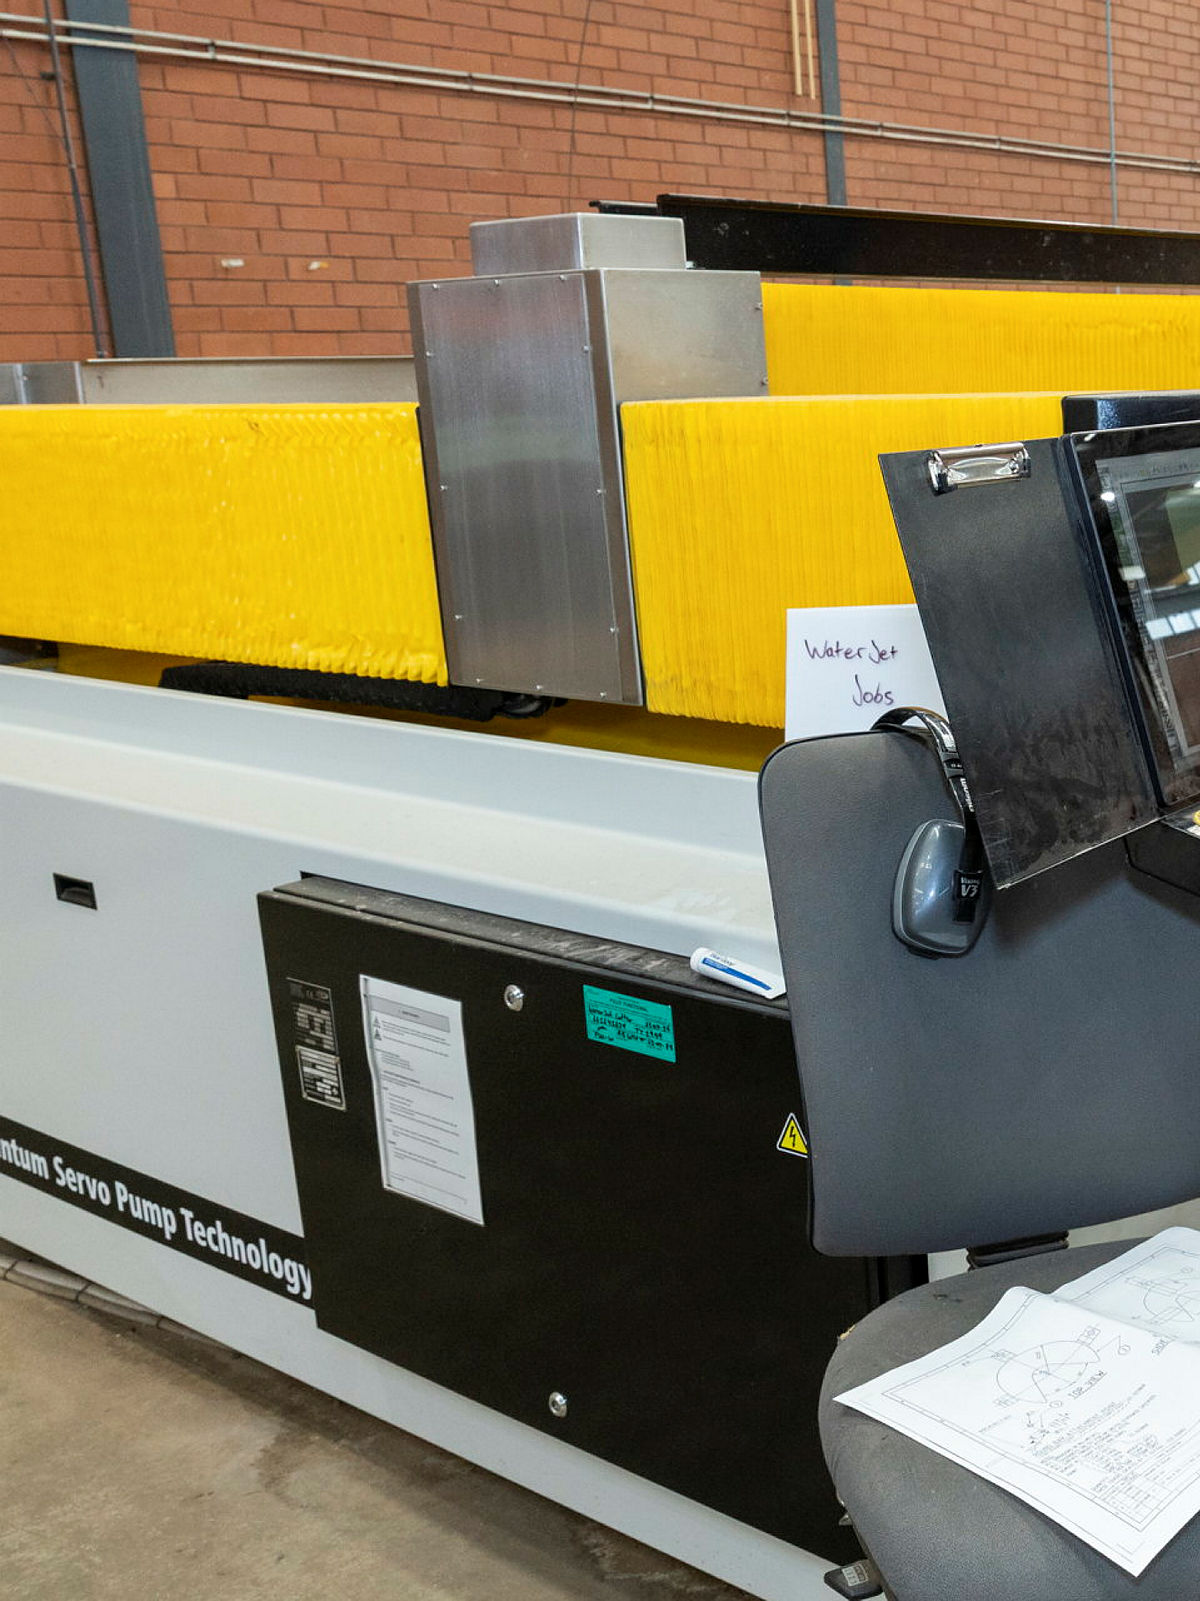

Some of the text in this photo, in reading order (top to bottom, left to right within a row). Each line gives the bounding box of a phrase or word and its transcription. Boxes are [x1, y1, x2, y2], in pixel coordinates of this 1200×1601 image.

[852, 674, 895, 707] Jobs
[0, 1138, 312, 1301] ntum Servo Pump Technology
